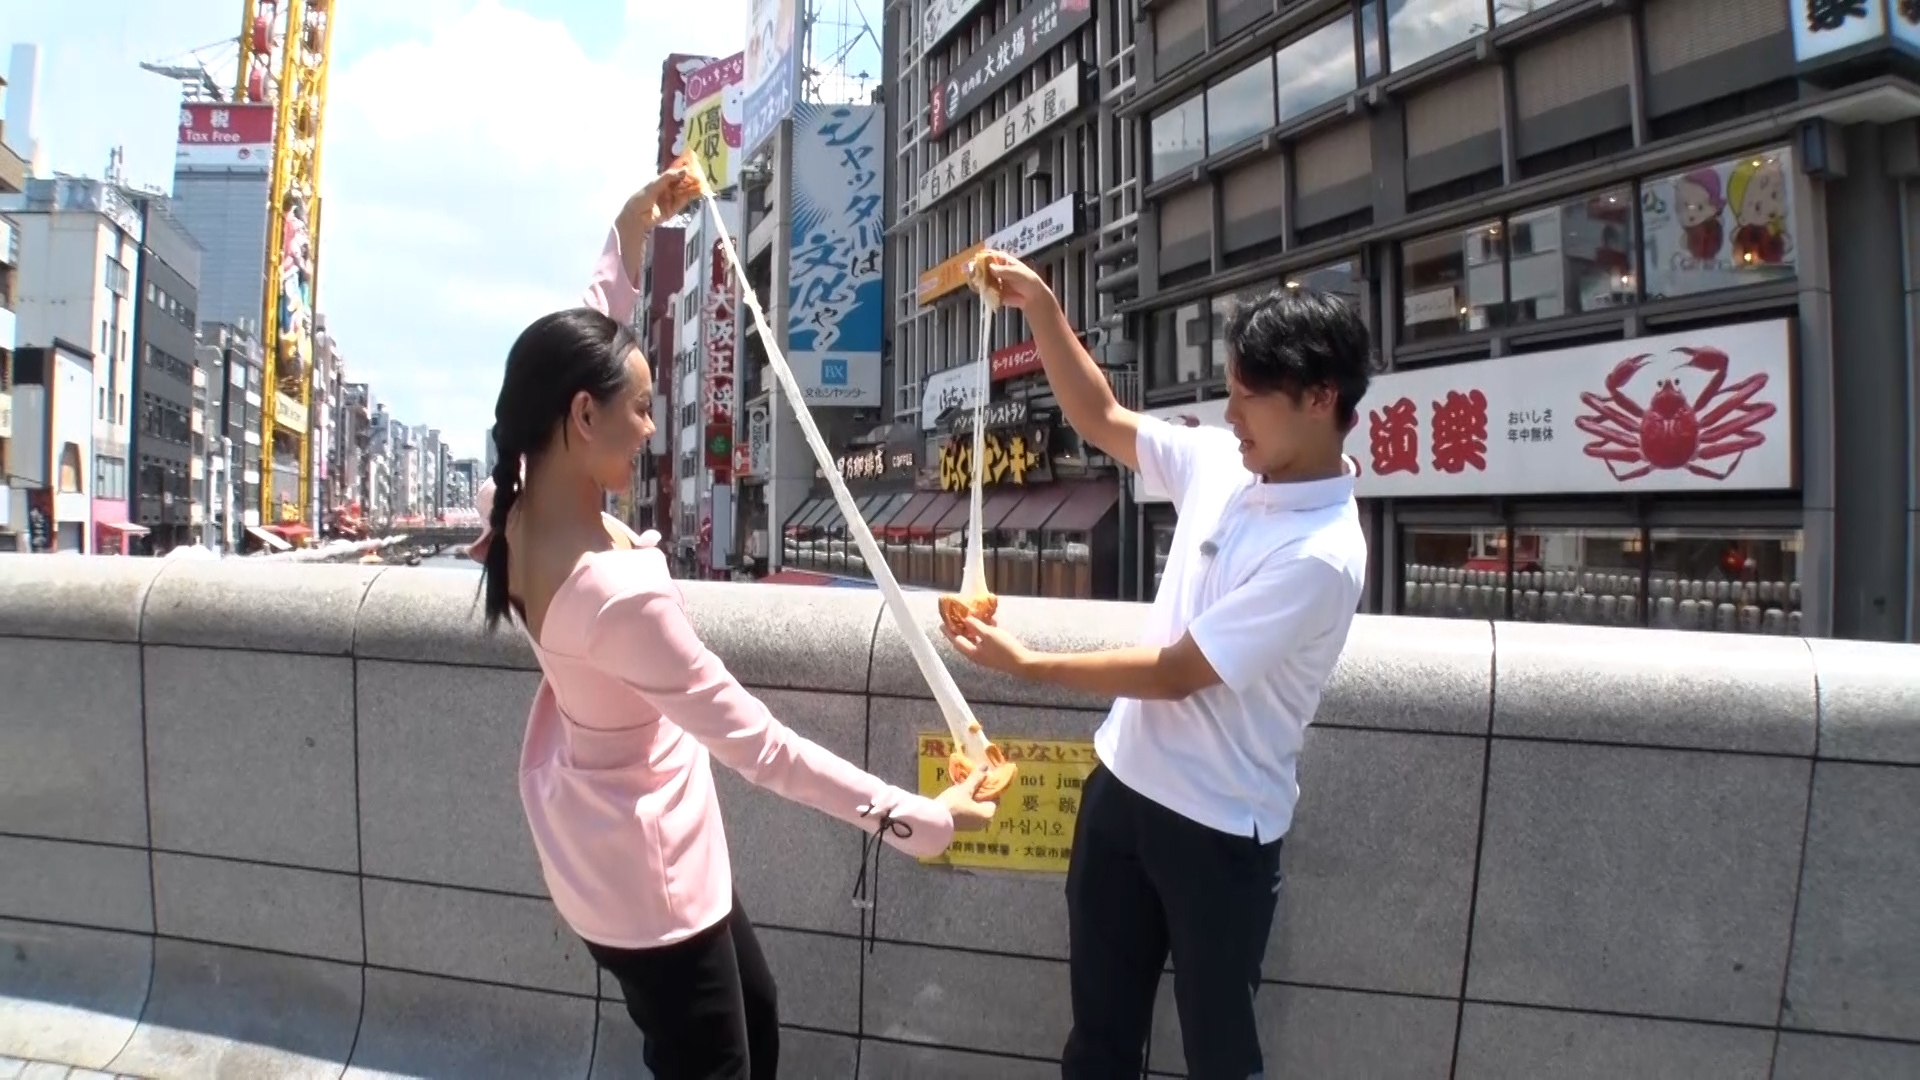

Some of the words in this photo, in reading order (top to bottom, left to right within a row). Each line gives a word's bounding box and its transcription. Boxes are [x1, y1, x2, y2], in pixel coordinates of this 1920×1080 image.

[1004, 88, 1057, 150] 白木屋
[186, 130, 209, 142] Tax
[212, 131, 241, 142] Free
[704, 105, 721, 184] 高収入
[932, 150, 971, 199] 白木屋
[817, 108, 881, 278] シャッターは
[703, 283, 735, 417] 大阪王将
[824, 366, 844, 379] BX
[805, 387, 867, 399] 文化シャッター
[954, 402, 1026, 429] ハンバグレストラン
[1507, 407, 1553, 425] おいしさ
[1343, 389, 1488, 477] 道樂
[1507, 426, 1553, 443] 年中無休
[1020, 774, 1045, 787] not
[1056, 773, 1085, 790] jum
[1022, 795, 1040, 812] 要
[999, 818, 1064, 836] 마십시오
